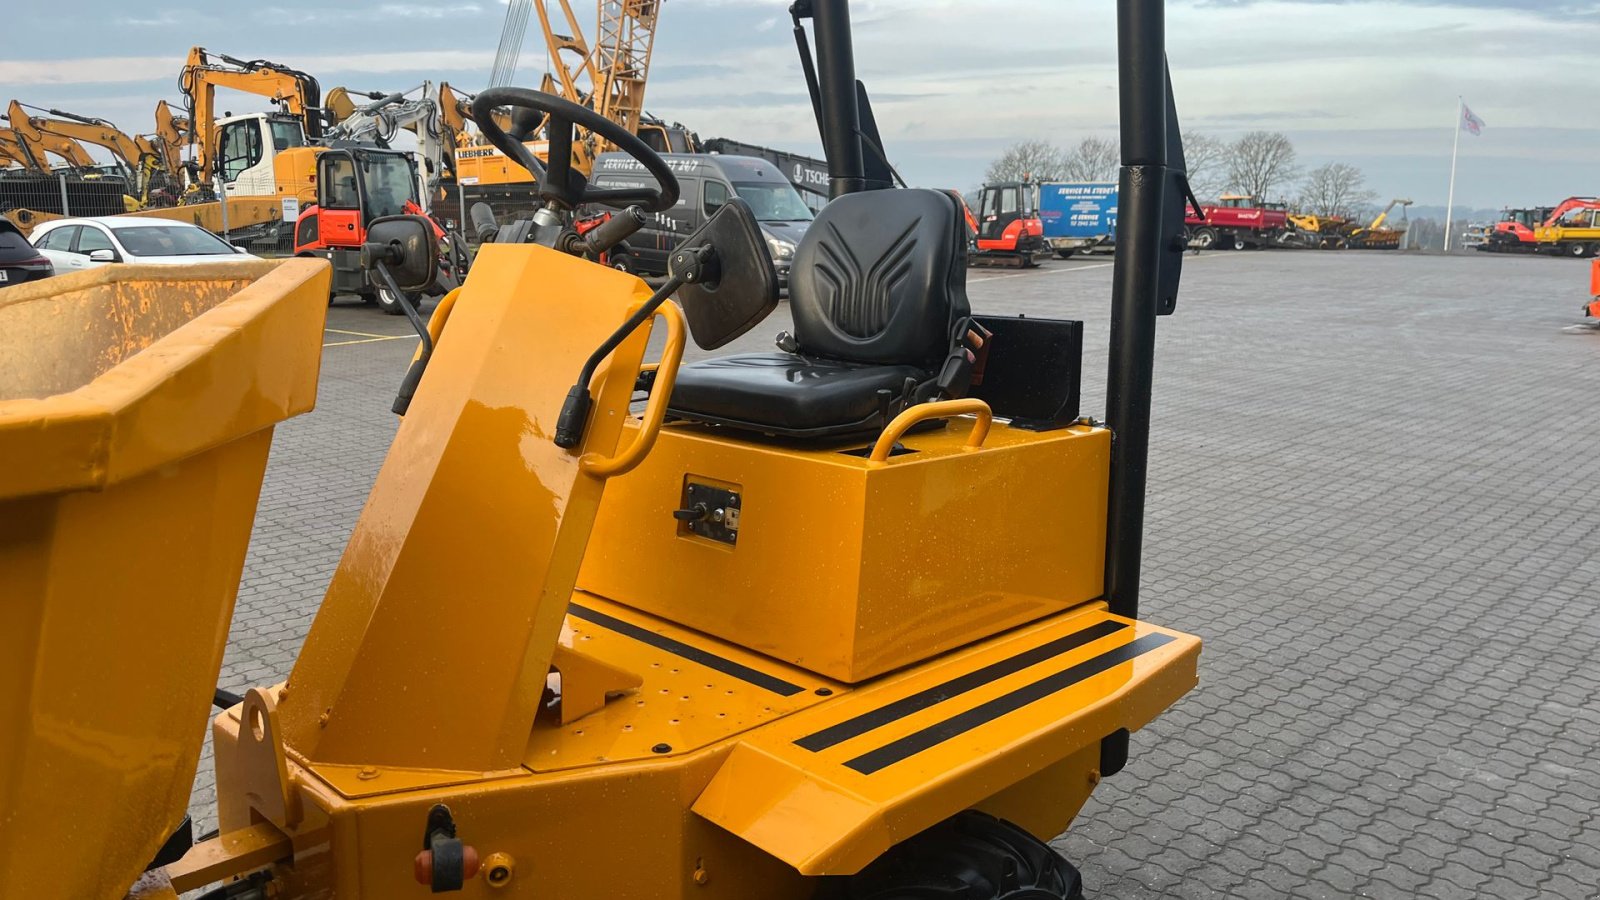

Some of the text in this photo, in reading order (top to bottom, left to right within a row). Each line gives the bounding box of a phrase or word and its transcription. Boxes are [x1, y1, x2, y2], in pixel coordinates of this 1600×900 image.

[458, 149, 494, 158] LIEBHERR
[604, 159, 635, 170] SERVICE
[678, 159, 699, 172] 24/7
[1058, 187, 1083, 195] SERVICE
